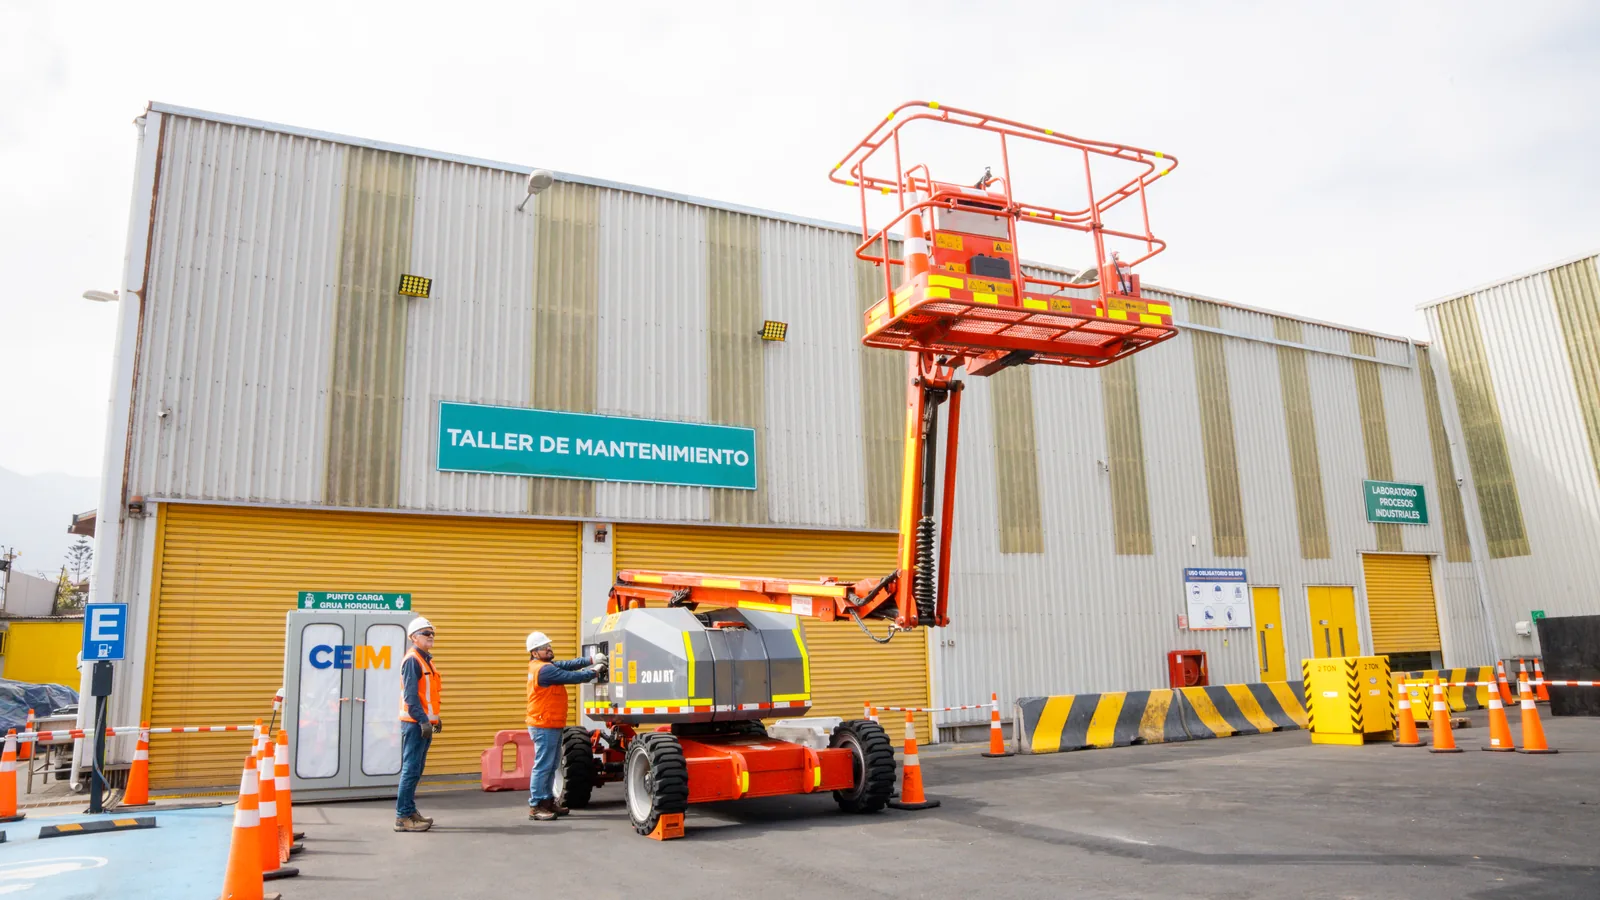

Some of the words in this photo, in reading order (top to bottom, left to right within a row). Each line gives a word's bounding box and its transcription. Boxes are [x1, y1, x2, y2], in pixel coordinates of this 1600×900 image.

[447, 428, 533, 452] TALLER
[540, 435, 570, 455] DE
[576, 438, 749, 467] MANTENIMIENTO
[1372, 486, 1417, 496] LABORATORIO
[1380, 498, 1413, 507] PROCESOS
[1375, 509, 1420, 519] INDUSTRIALES
[326, 593, 354, 601] PUNTO
[344, 602, 390, 610] HORQUILLA
[90, 608, 120, 641] E
[309, 644, 392, 670] CEIM
[1323, 664, 1337, 672] TON
[641, 670, 652, 683] 20
[653, 670, 662, 683] AJ
[663, 669, 674, 682] RT
